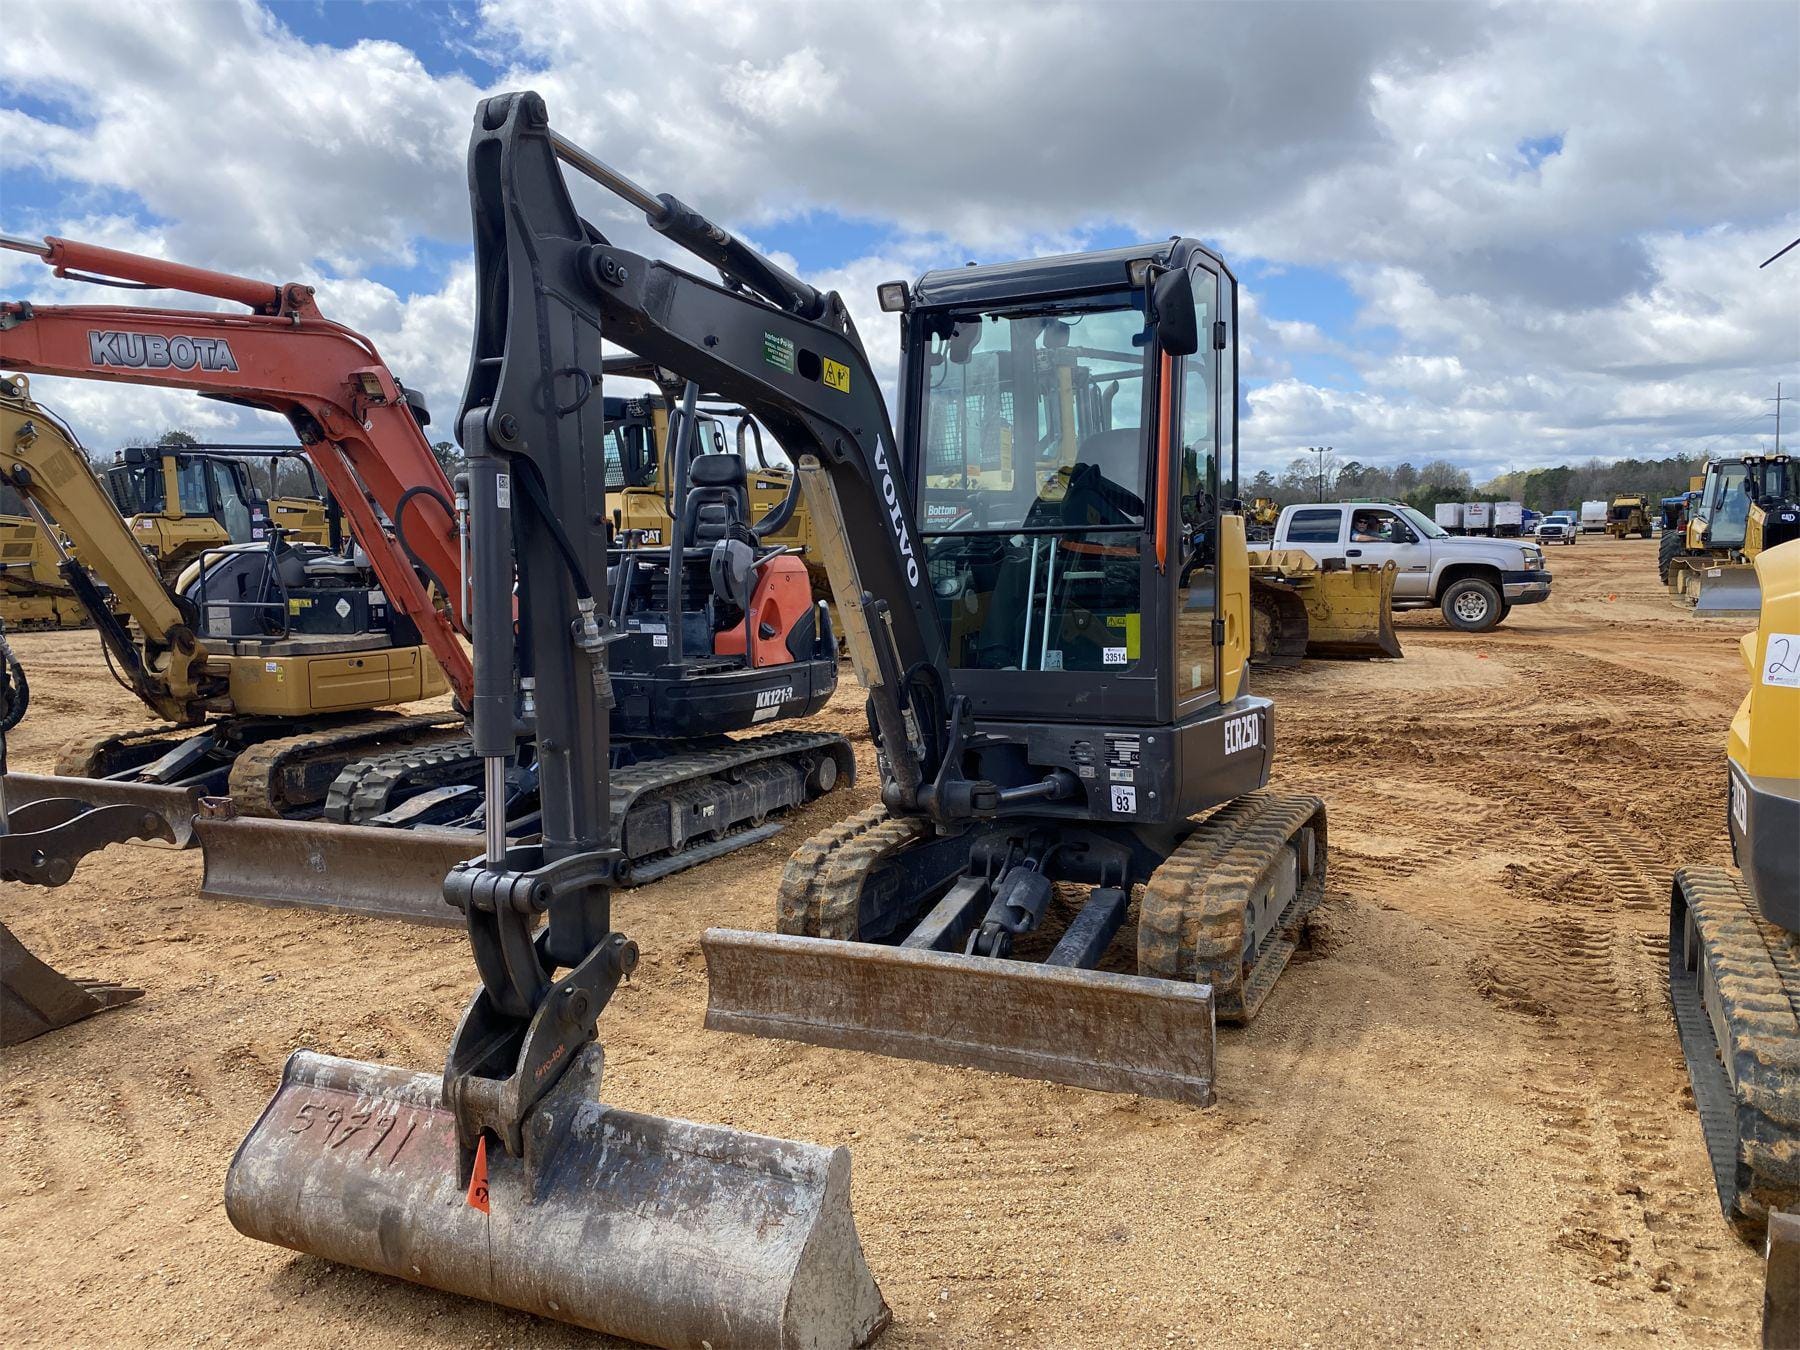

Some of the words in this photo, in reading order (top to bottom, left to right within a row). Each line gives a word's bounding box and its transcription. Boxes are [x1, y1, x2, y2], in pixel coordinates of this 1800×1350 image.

[88, 331, 240, 371] KUBOTA
[874, 433, 919, 588] VOLVO
[928, 505, 957, 515] Bottom
[641, 529, 661, 544] CAT
[410, 651, 417, 665] 7
[1105, 652, 1126, 662] 33514
[755, 686, 793, 708] KX121-3
[1224, 713, 1259, 755] ECR25D
[1116, 795, 1130, 811] 93
